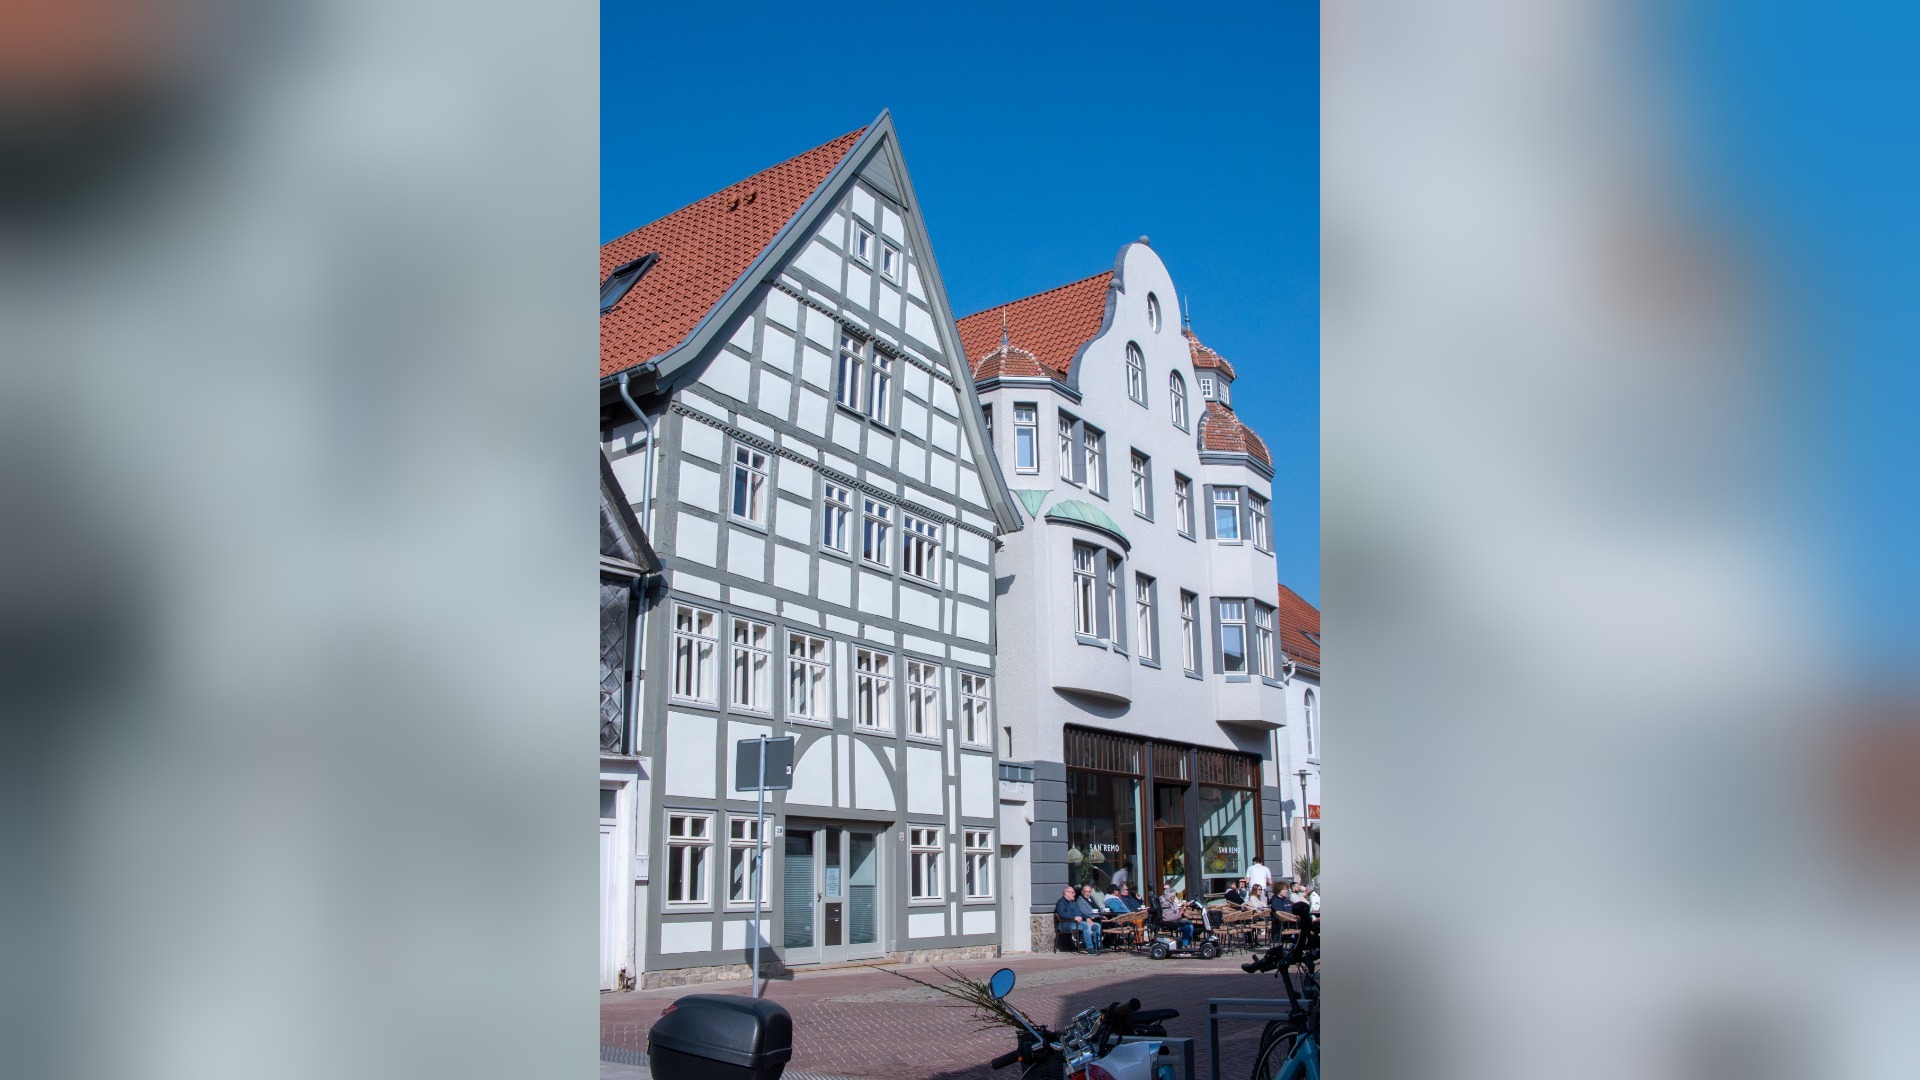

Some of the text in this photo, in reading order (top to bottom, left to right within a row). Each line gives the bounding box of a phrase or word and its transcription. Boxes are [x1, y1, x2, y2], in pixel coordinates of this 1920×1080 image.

[1089, 843, 1120, 852] SAN REMO
[1218, 846, 1228, 854] SAN
